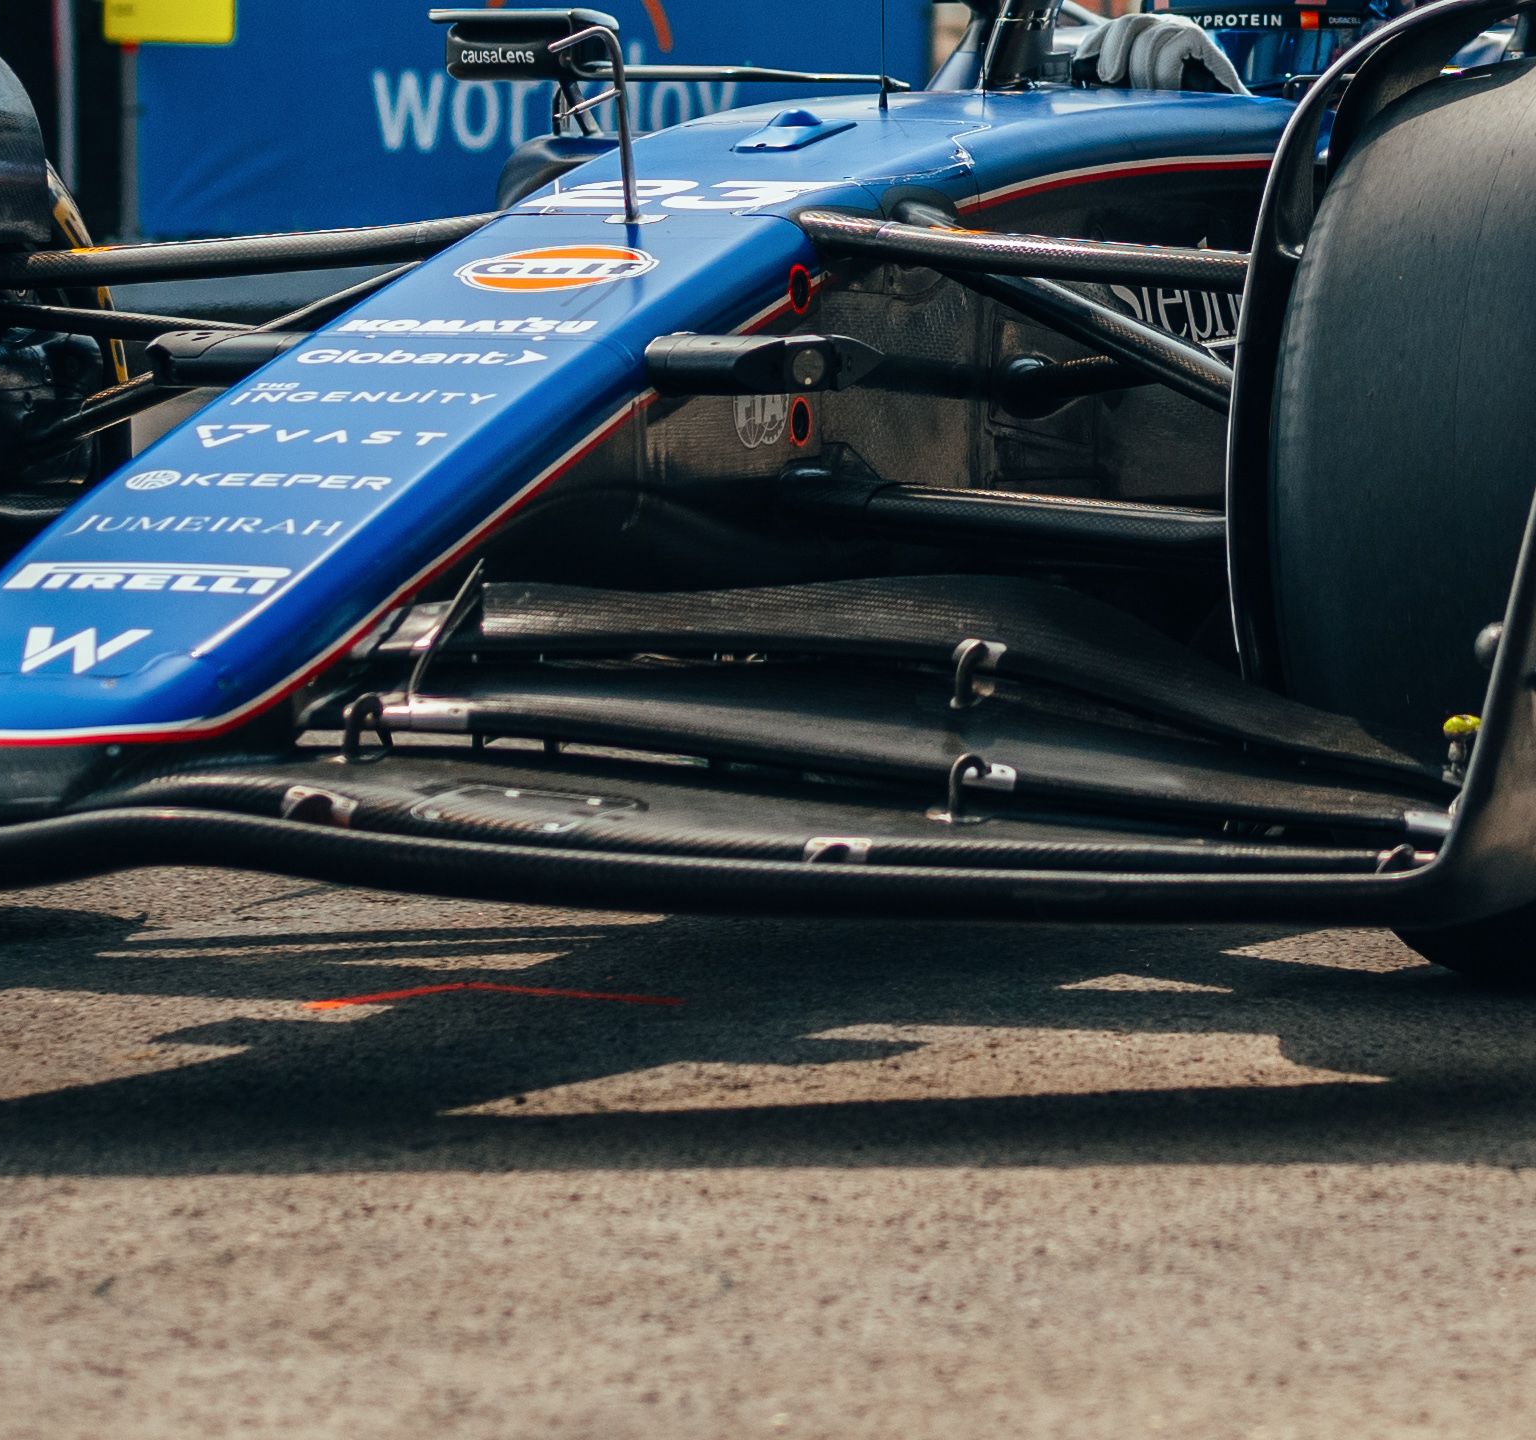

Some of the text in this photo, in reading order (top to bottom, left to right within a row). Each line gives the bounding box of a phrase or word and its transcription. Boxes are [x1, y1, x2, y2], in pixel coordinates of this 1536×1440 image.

[1187, 13, 1282, 27] YPROTEIN
[461, 48, 535, 65] causaLens
[519, 180, 852, 210] 23
[472, 261, 645, 277] Gulf
[337, 318, 599, 334] KOMATSU
[296, 348, 510, 366] Globant
[230, 389, 499, 407] INGENUITY
[275, 429, 448, 447] VAST
[179, 472, 393, 491] KEEPER
[64, 514, 344, 537] JUMEIRAH
[2, 562, 292, 596] PIRELLI
[20, 626, 154, 675] W
